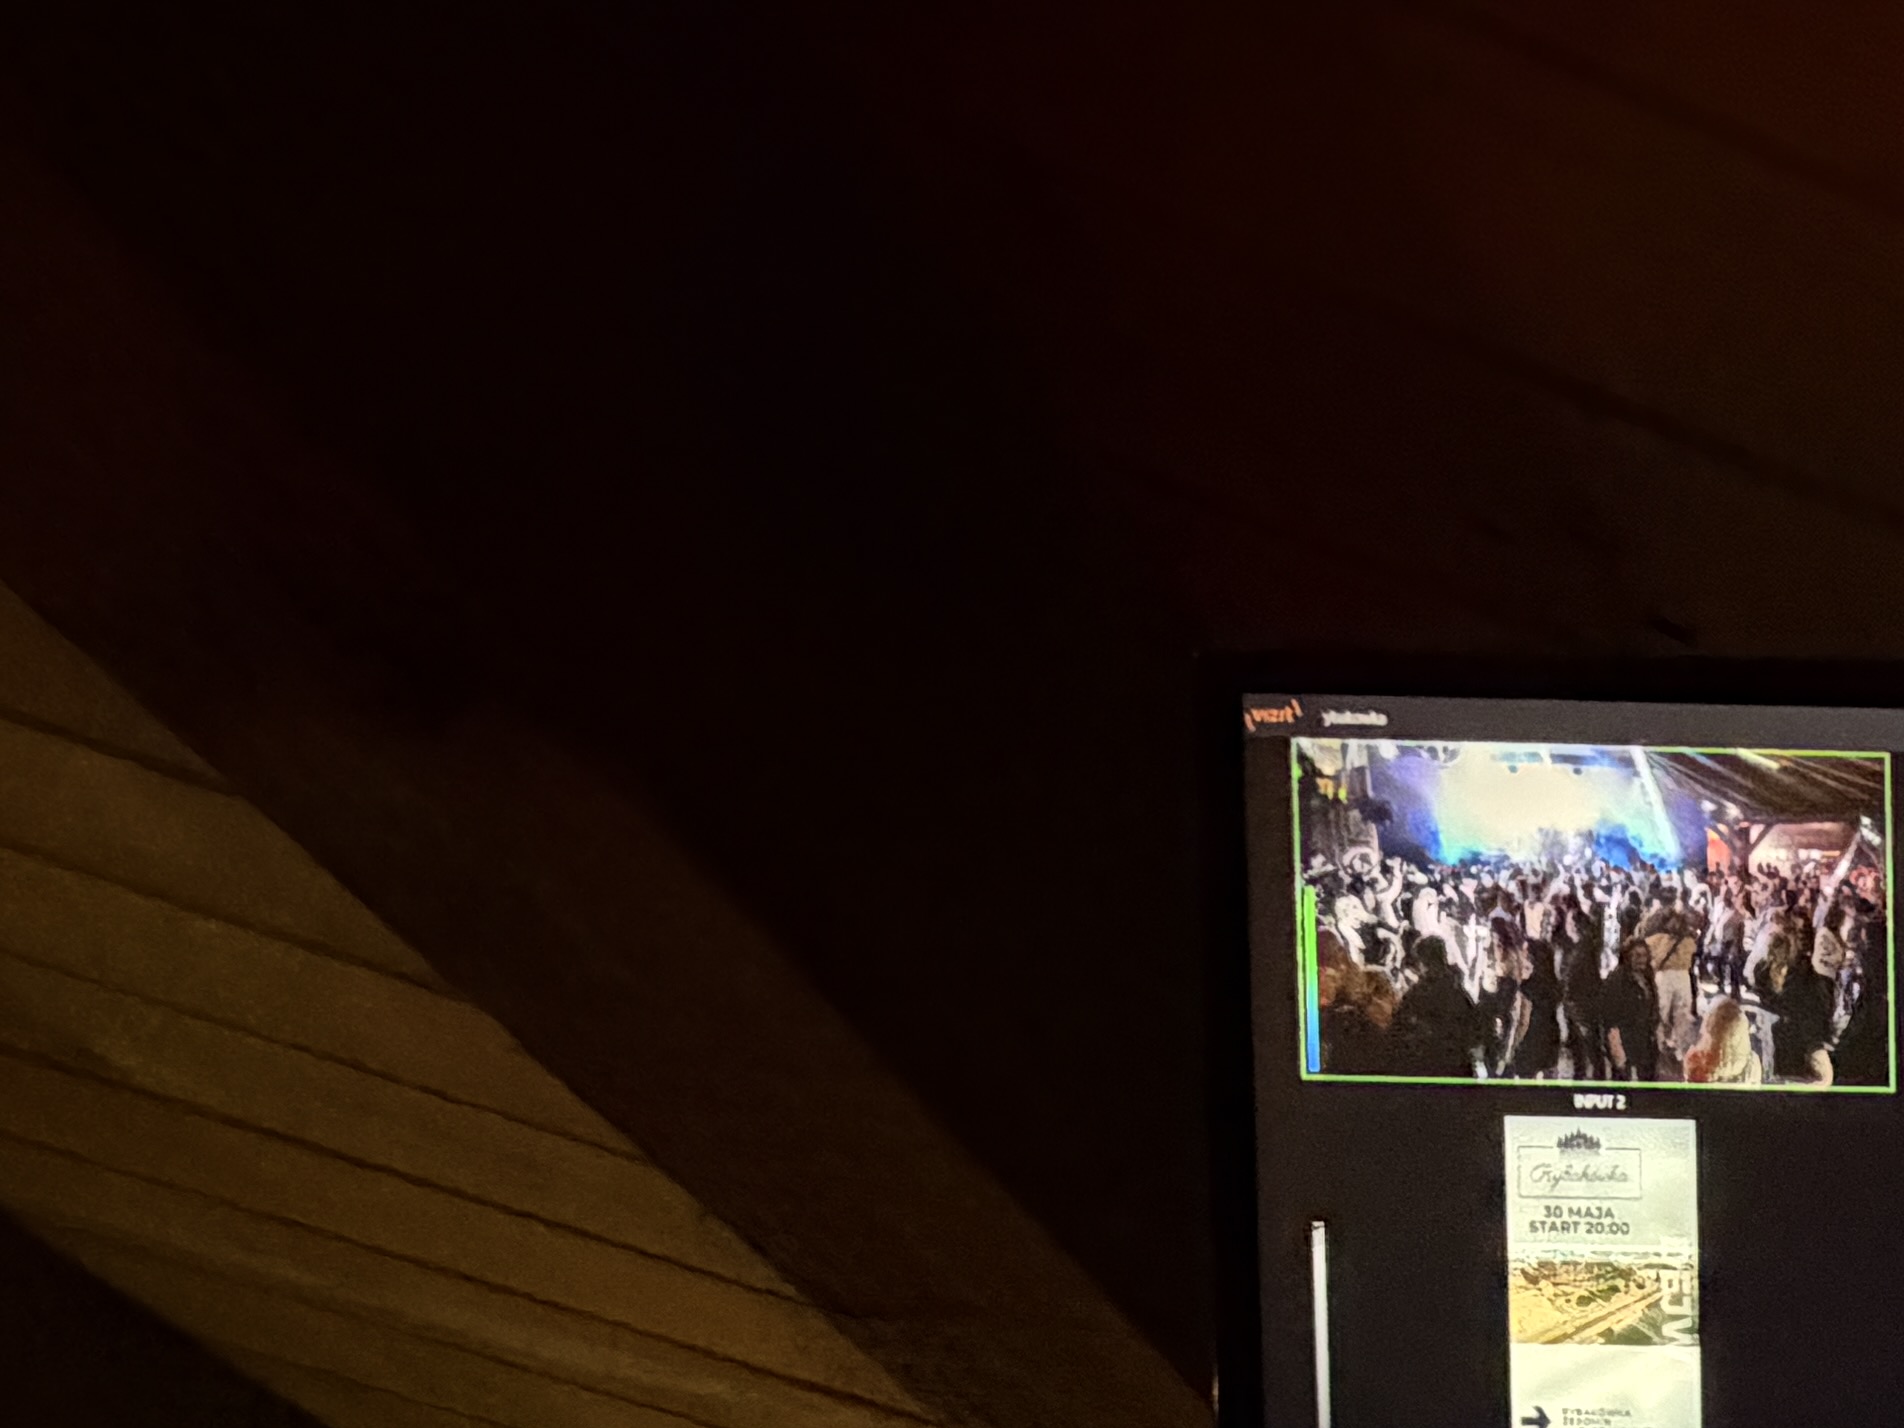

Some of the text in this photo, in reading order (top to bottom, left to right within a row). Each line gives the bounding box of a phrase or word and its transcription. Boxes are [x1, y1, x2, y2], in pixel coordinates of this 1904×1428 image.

[1544, 1205, 1615, 1219] 30 MAJA
[1529, 1221, 1630, 1235] START 20:00
